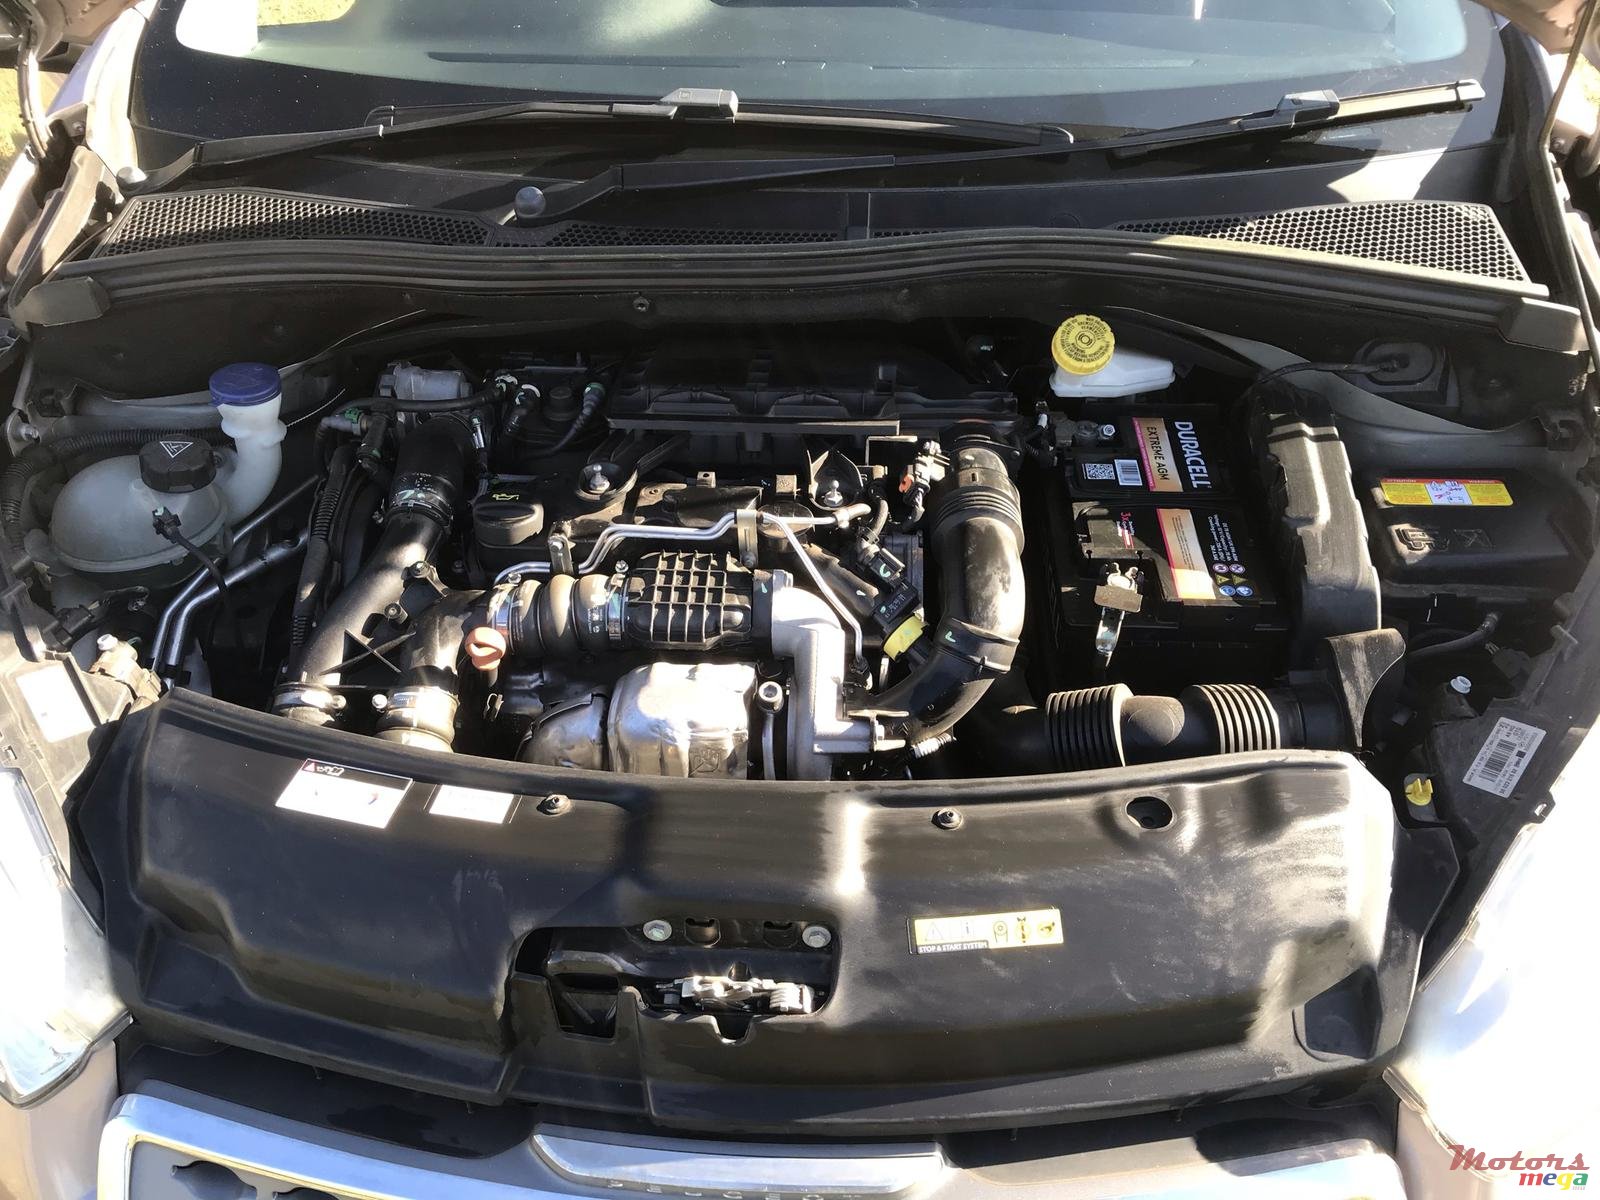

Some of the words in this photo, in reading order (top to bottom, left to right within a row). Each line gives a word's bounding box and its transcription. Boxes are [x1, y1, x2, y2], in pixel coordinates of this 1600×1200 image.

[1147, 426, 1165, 461] EXTREME
[1156, 461, 1169, 481] AGM
[1174, 421, 1211, 488] DURACELL
[919, 945, 936, 953] STOP
[942, 944, 962, 952] START
